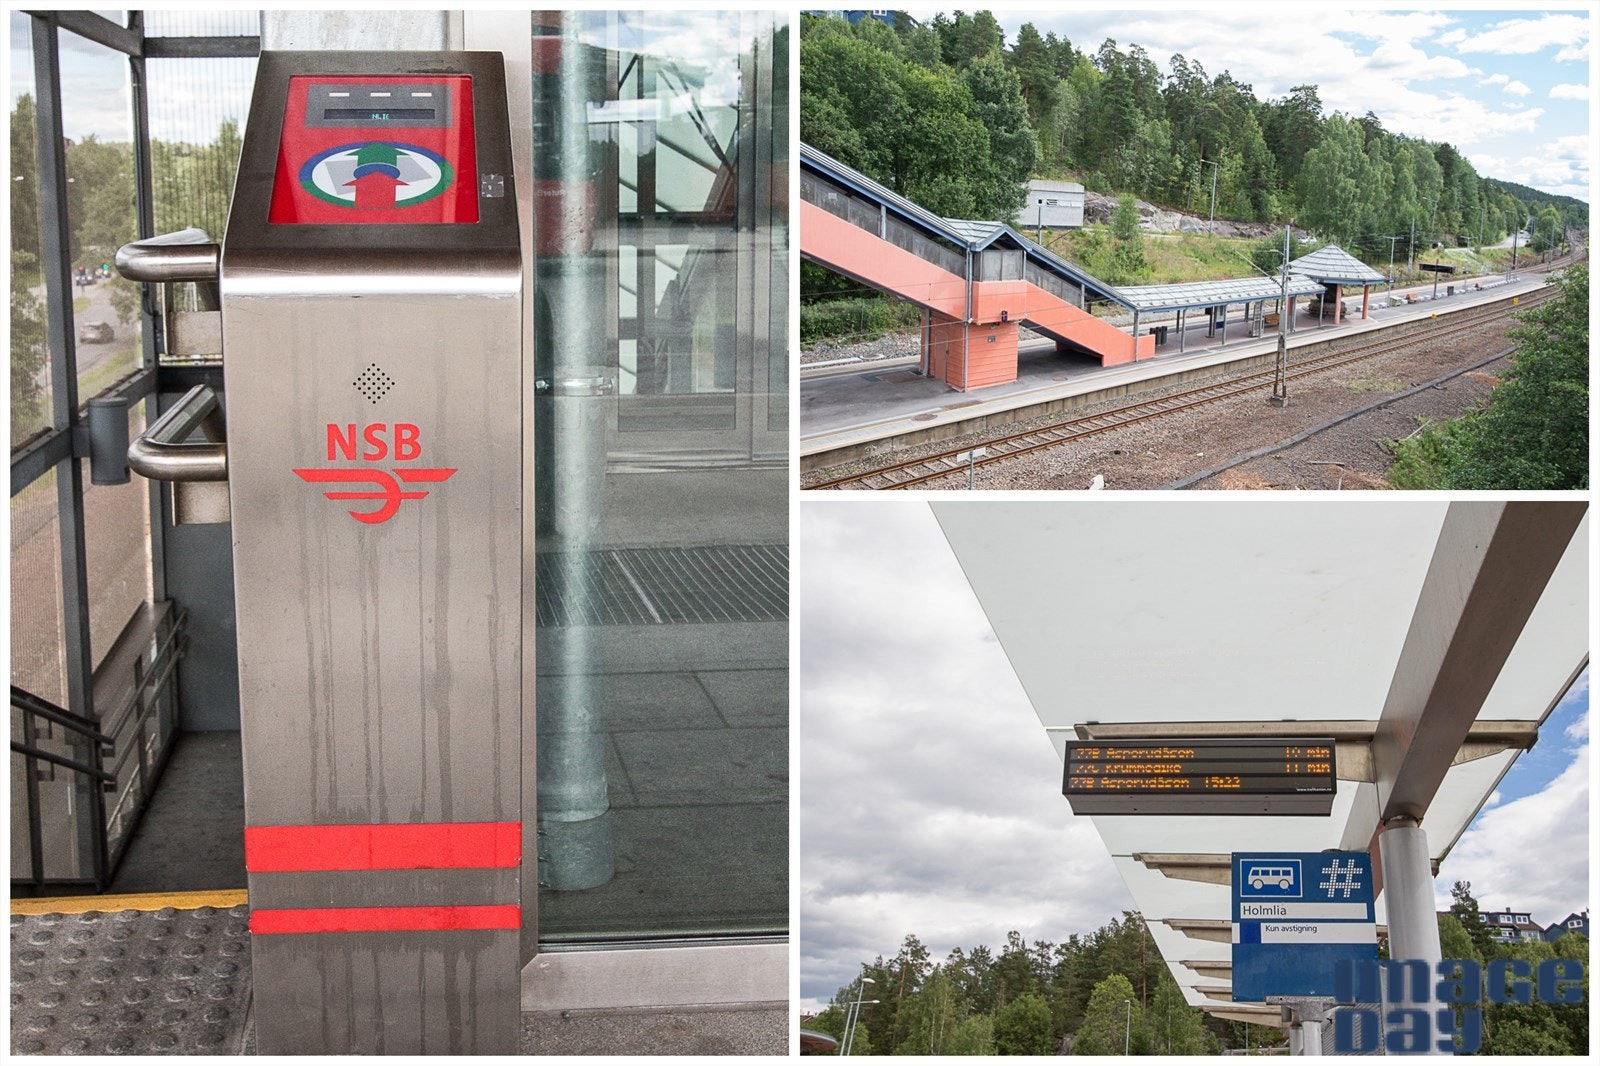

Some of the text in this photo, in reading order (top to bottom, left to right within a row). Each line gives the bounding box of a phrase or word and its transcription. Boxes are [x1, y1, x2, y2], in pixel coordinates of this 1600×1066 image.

[326, 422, 422, 462] NSB
[1306, 747, 1330, 758] min
[1307, 763, 1331, 773] min
[1243, 905, 1287, 916] Holmlia
[1281, 925, 1318, 934] avstigning
